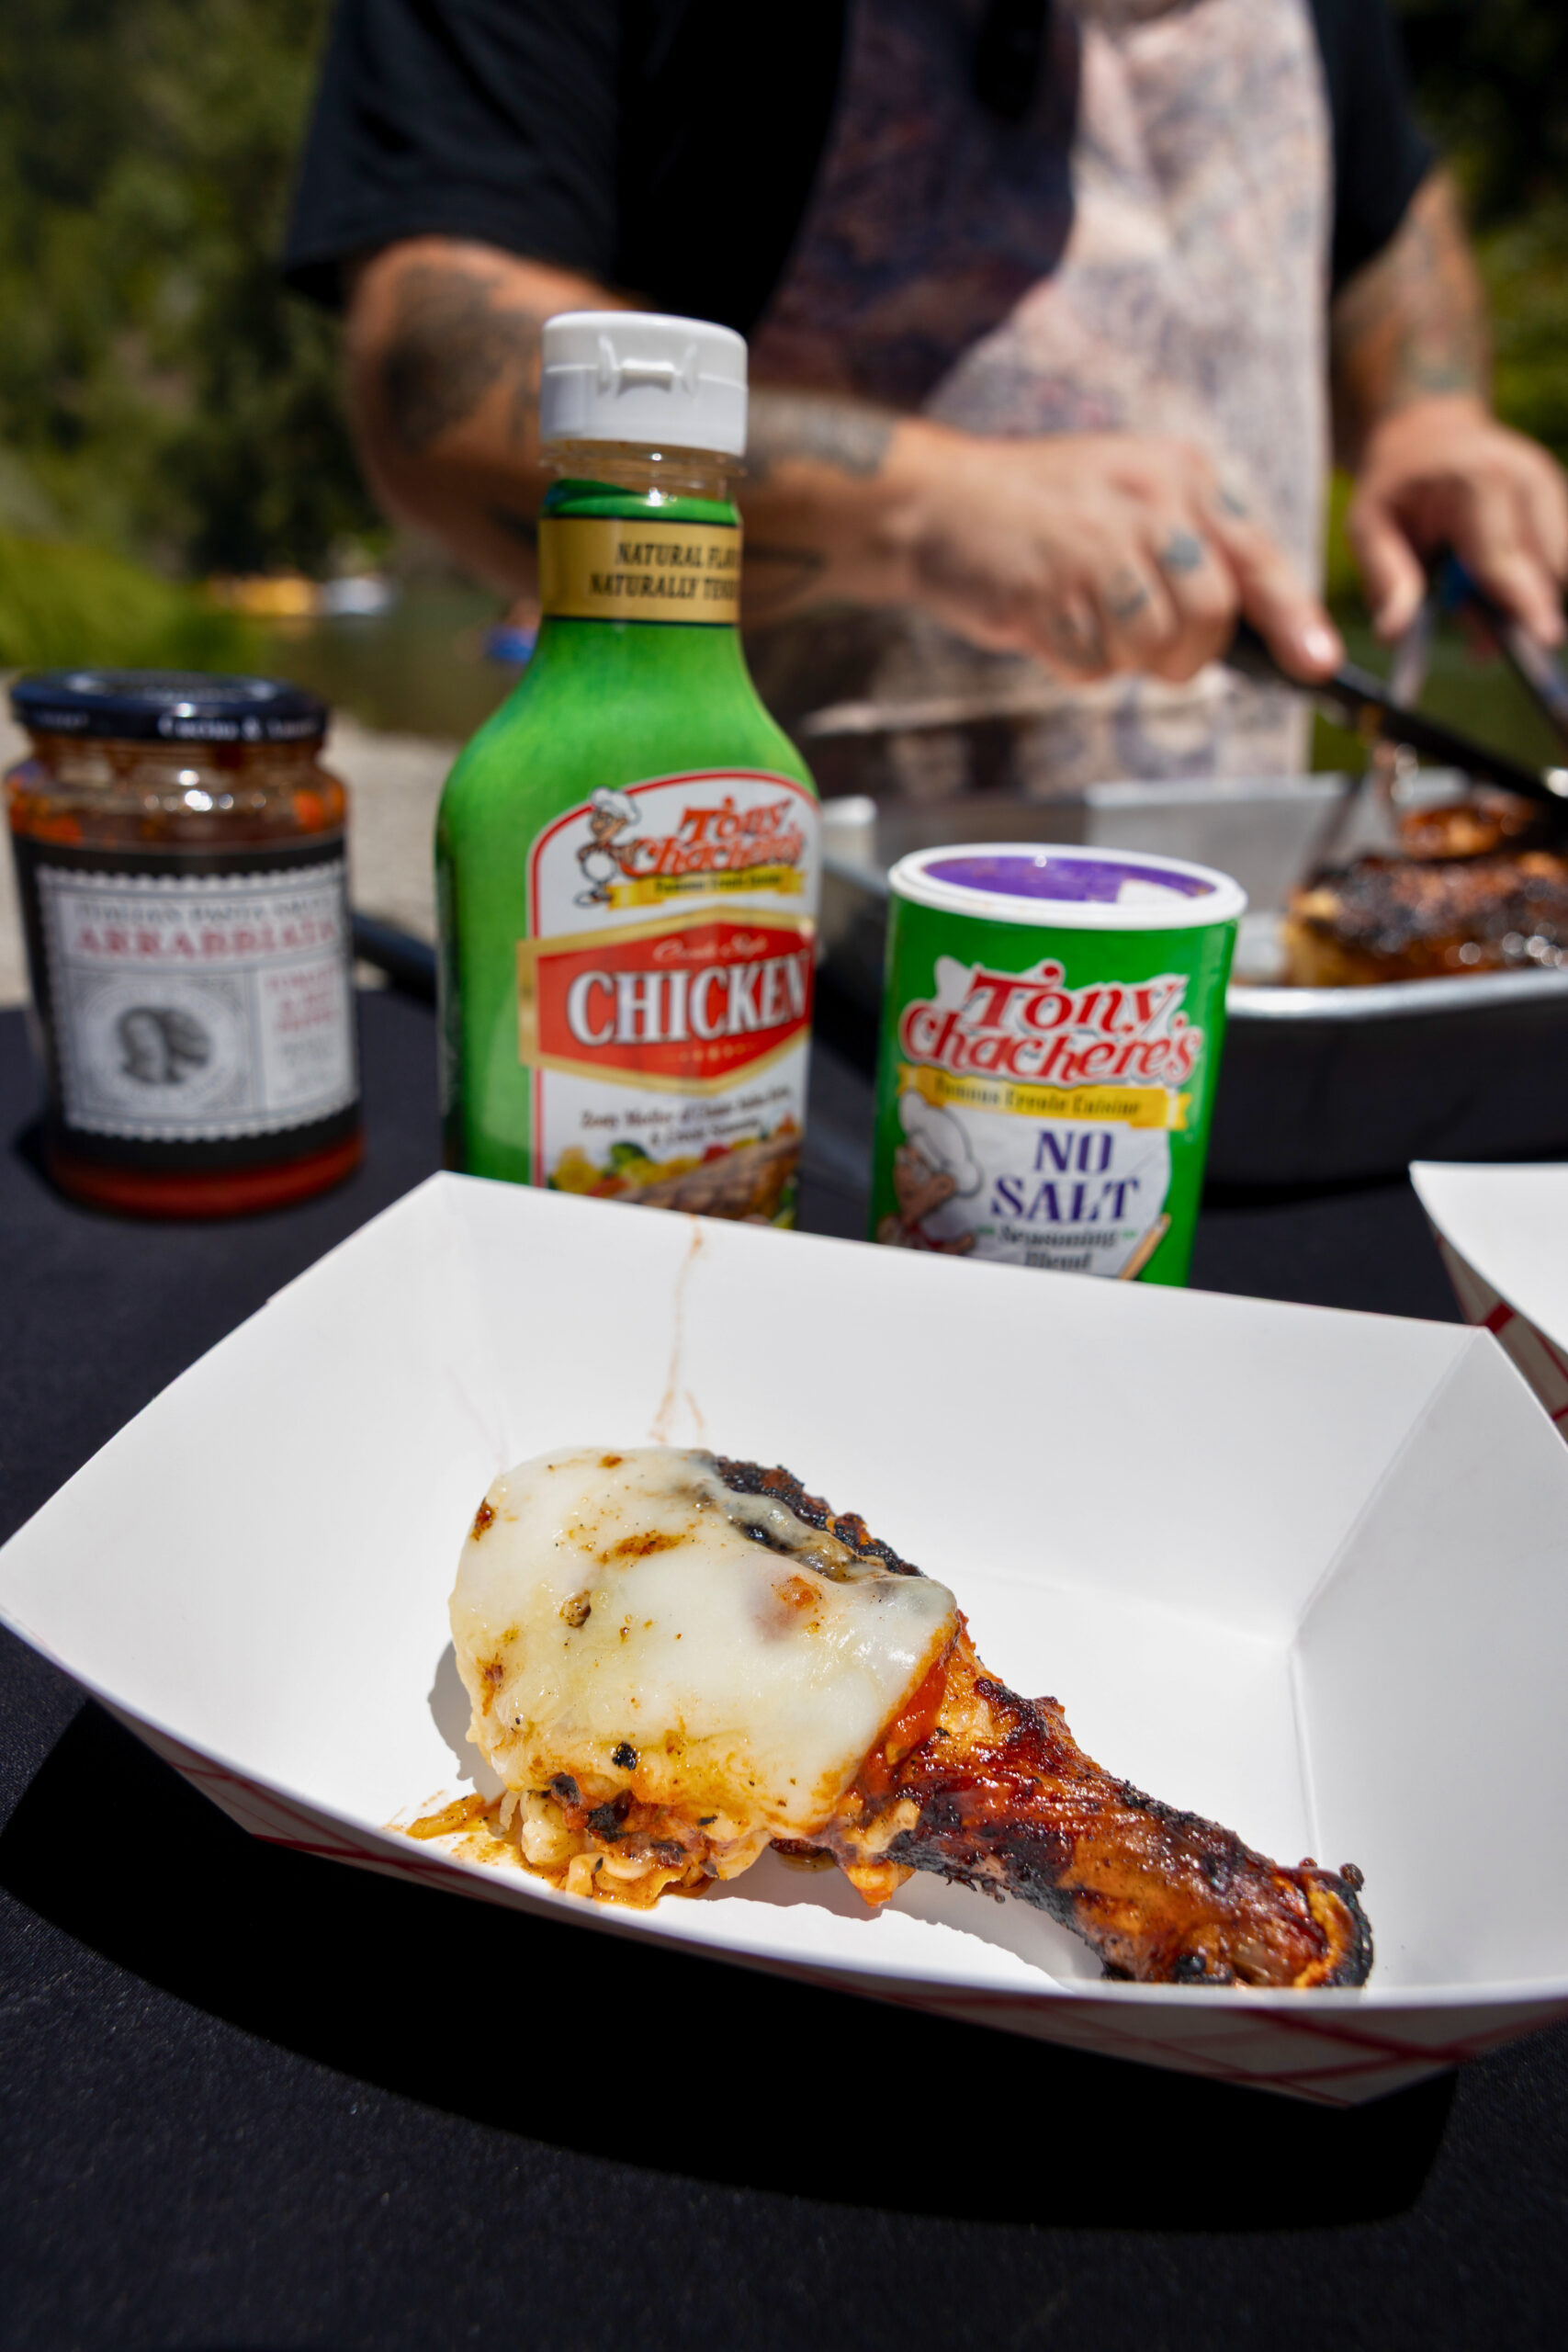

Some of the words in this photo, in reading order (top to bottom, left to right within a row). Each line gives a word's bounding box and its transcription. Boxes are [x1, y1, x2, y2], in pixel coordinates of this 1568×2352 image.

[616, 541, 702, 568] NATURAL
[590, 572, 698, 598] NATURALLY
[680, 797, 792, 844] Tony
[567, 951, 810, 1046] CHICKEN
[964, 962, 1185, 1036] Tony
[904, 1001, 1201, 1084] Chachere's
[1033, 1128, 1113, 1174] NO
[990, 1174, 1141, 1223] SALT
